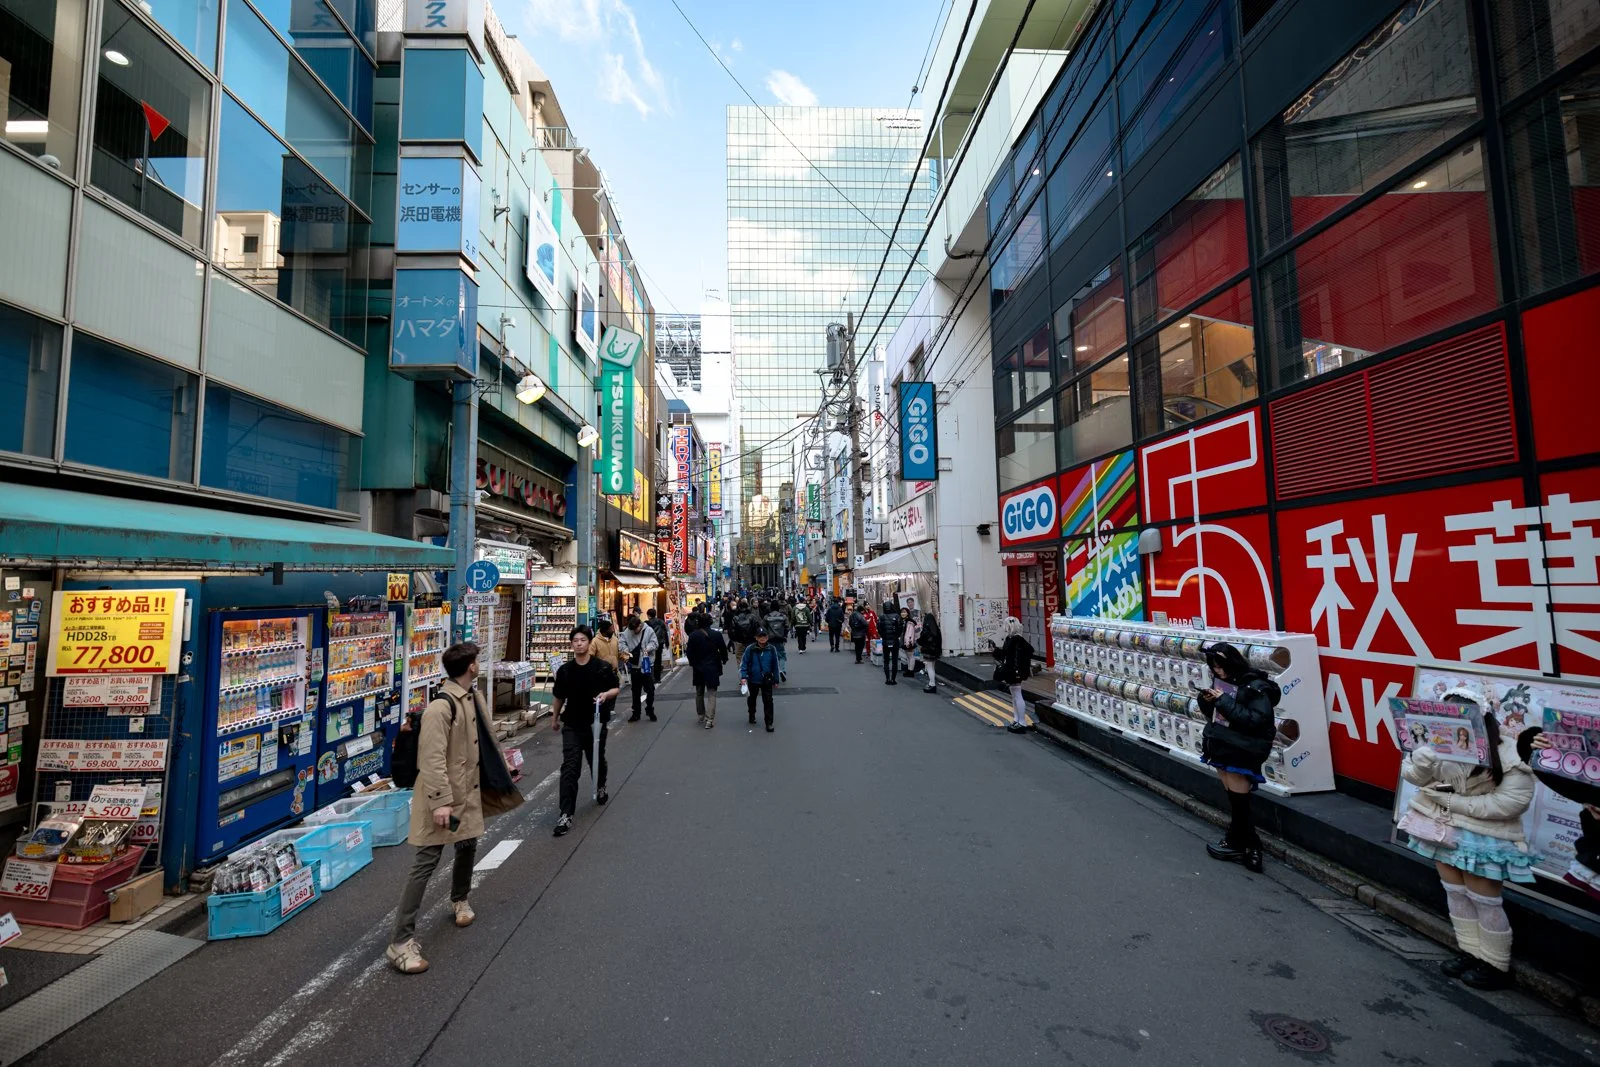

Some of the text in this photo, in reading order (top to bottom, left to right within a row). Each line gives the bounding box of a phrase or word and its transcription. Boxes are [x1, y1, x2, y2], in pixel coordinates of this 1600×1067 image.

[425, 0, 448, 27] クス
[402, 183, 460, 195] センサーの
[400, 206, 461, 222] 浜田電機
[398, 296, 456, 308] オートメの
[396, 315, 457, 338] ハマダ
[611, 372, 623, 490] TSUKUMO
[908, 397, 928, 464] GiGO
[1004, 493, 1052, 534] GiGO
[473, 569, 486, 588] P
[482, 580, 492, 588] 60
[1306, 493, 1600, 676] 秋葉
[389, 583, 408, 600] 100
[70, 596, 166, 613] おすすめ品!!
[73, 645, 154, 668] 77,800
[100, 806, 130, 816] 500
[14, 883, 48, 895] ¥250
